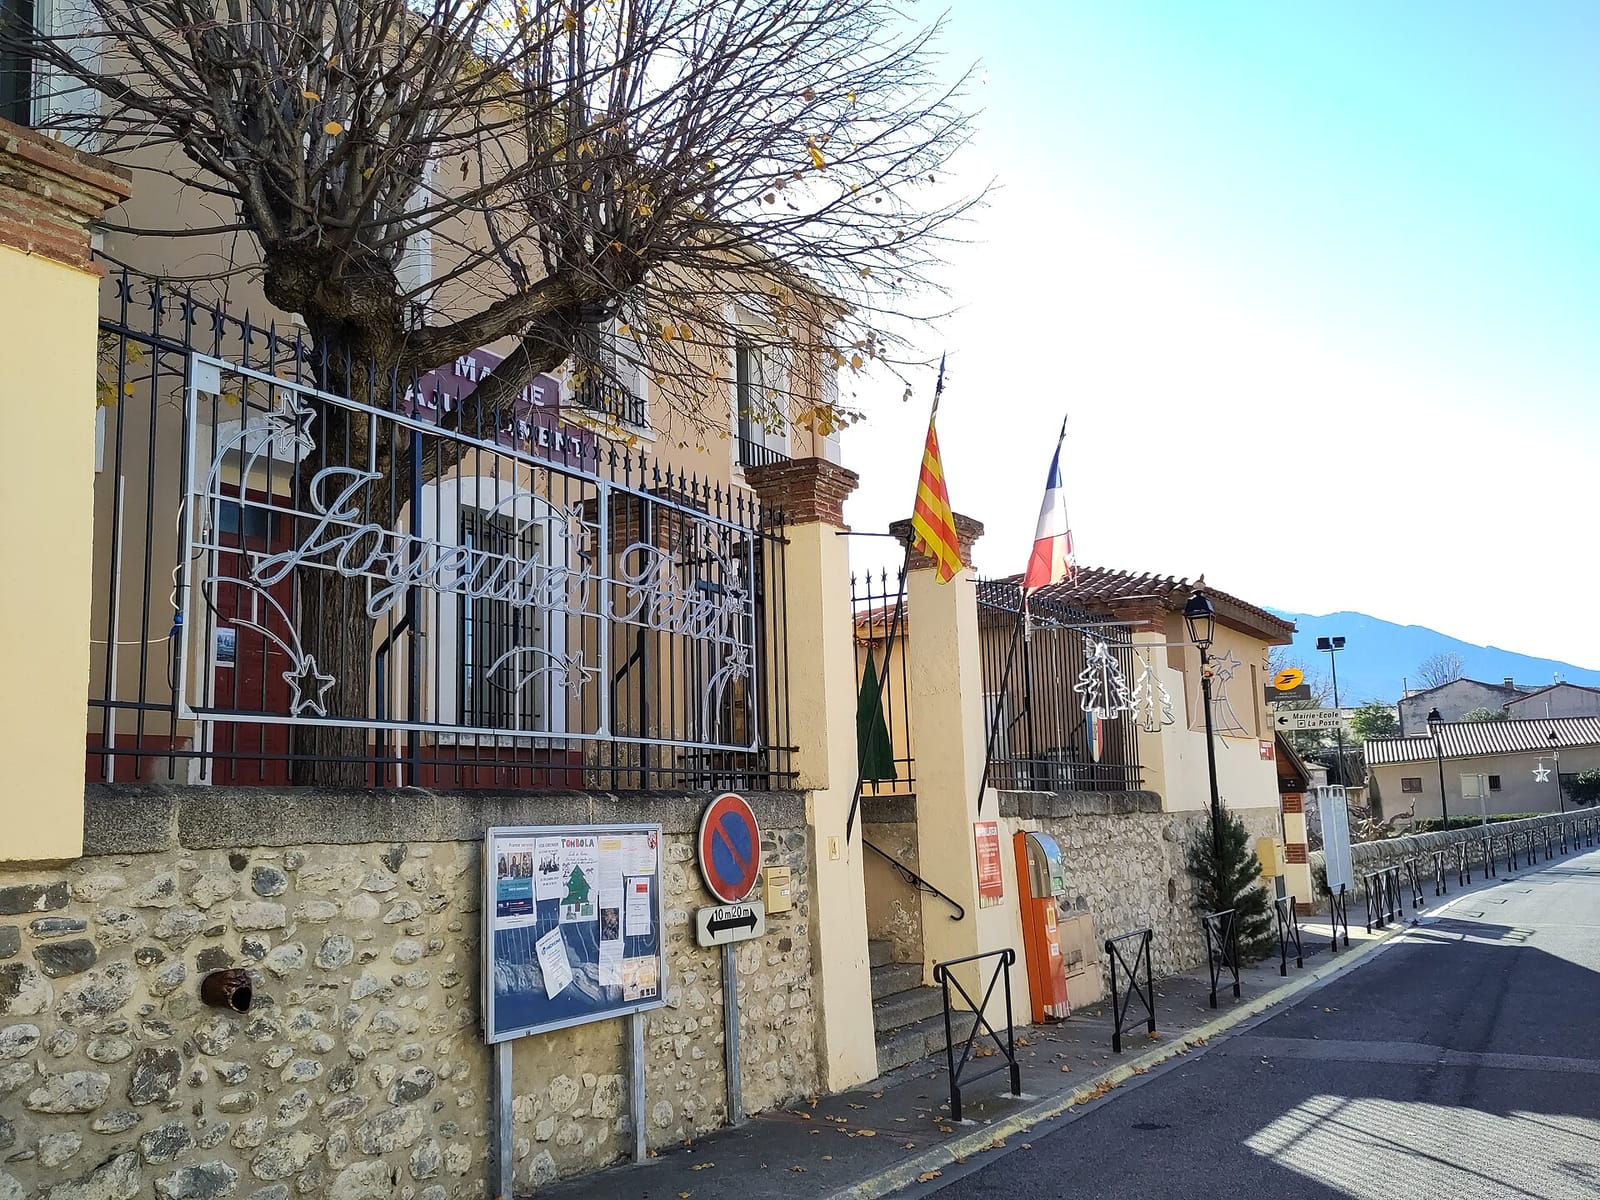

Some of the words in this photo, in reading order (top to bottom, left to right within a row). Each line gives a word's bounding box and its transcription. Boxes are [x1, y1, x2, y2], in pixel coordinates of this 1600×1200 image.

[250, 466, 592, 619] Joyeuses
[1318, 719, 1340, 727] Poste
[561, 838, 595, 848] TOMBOLA
